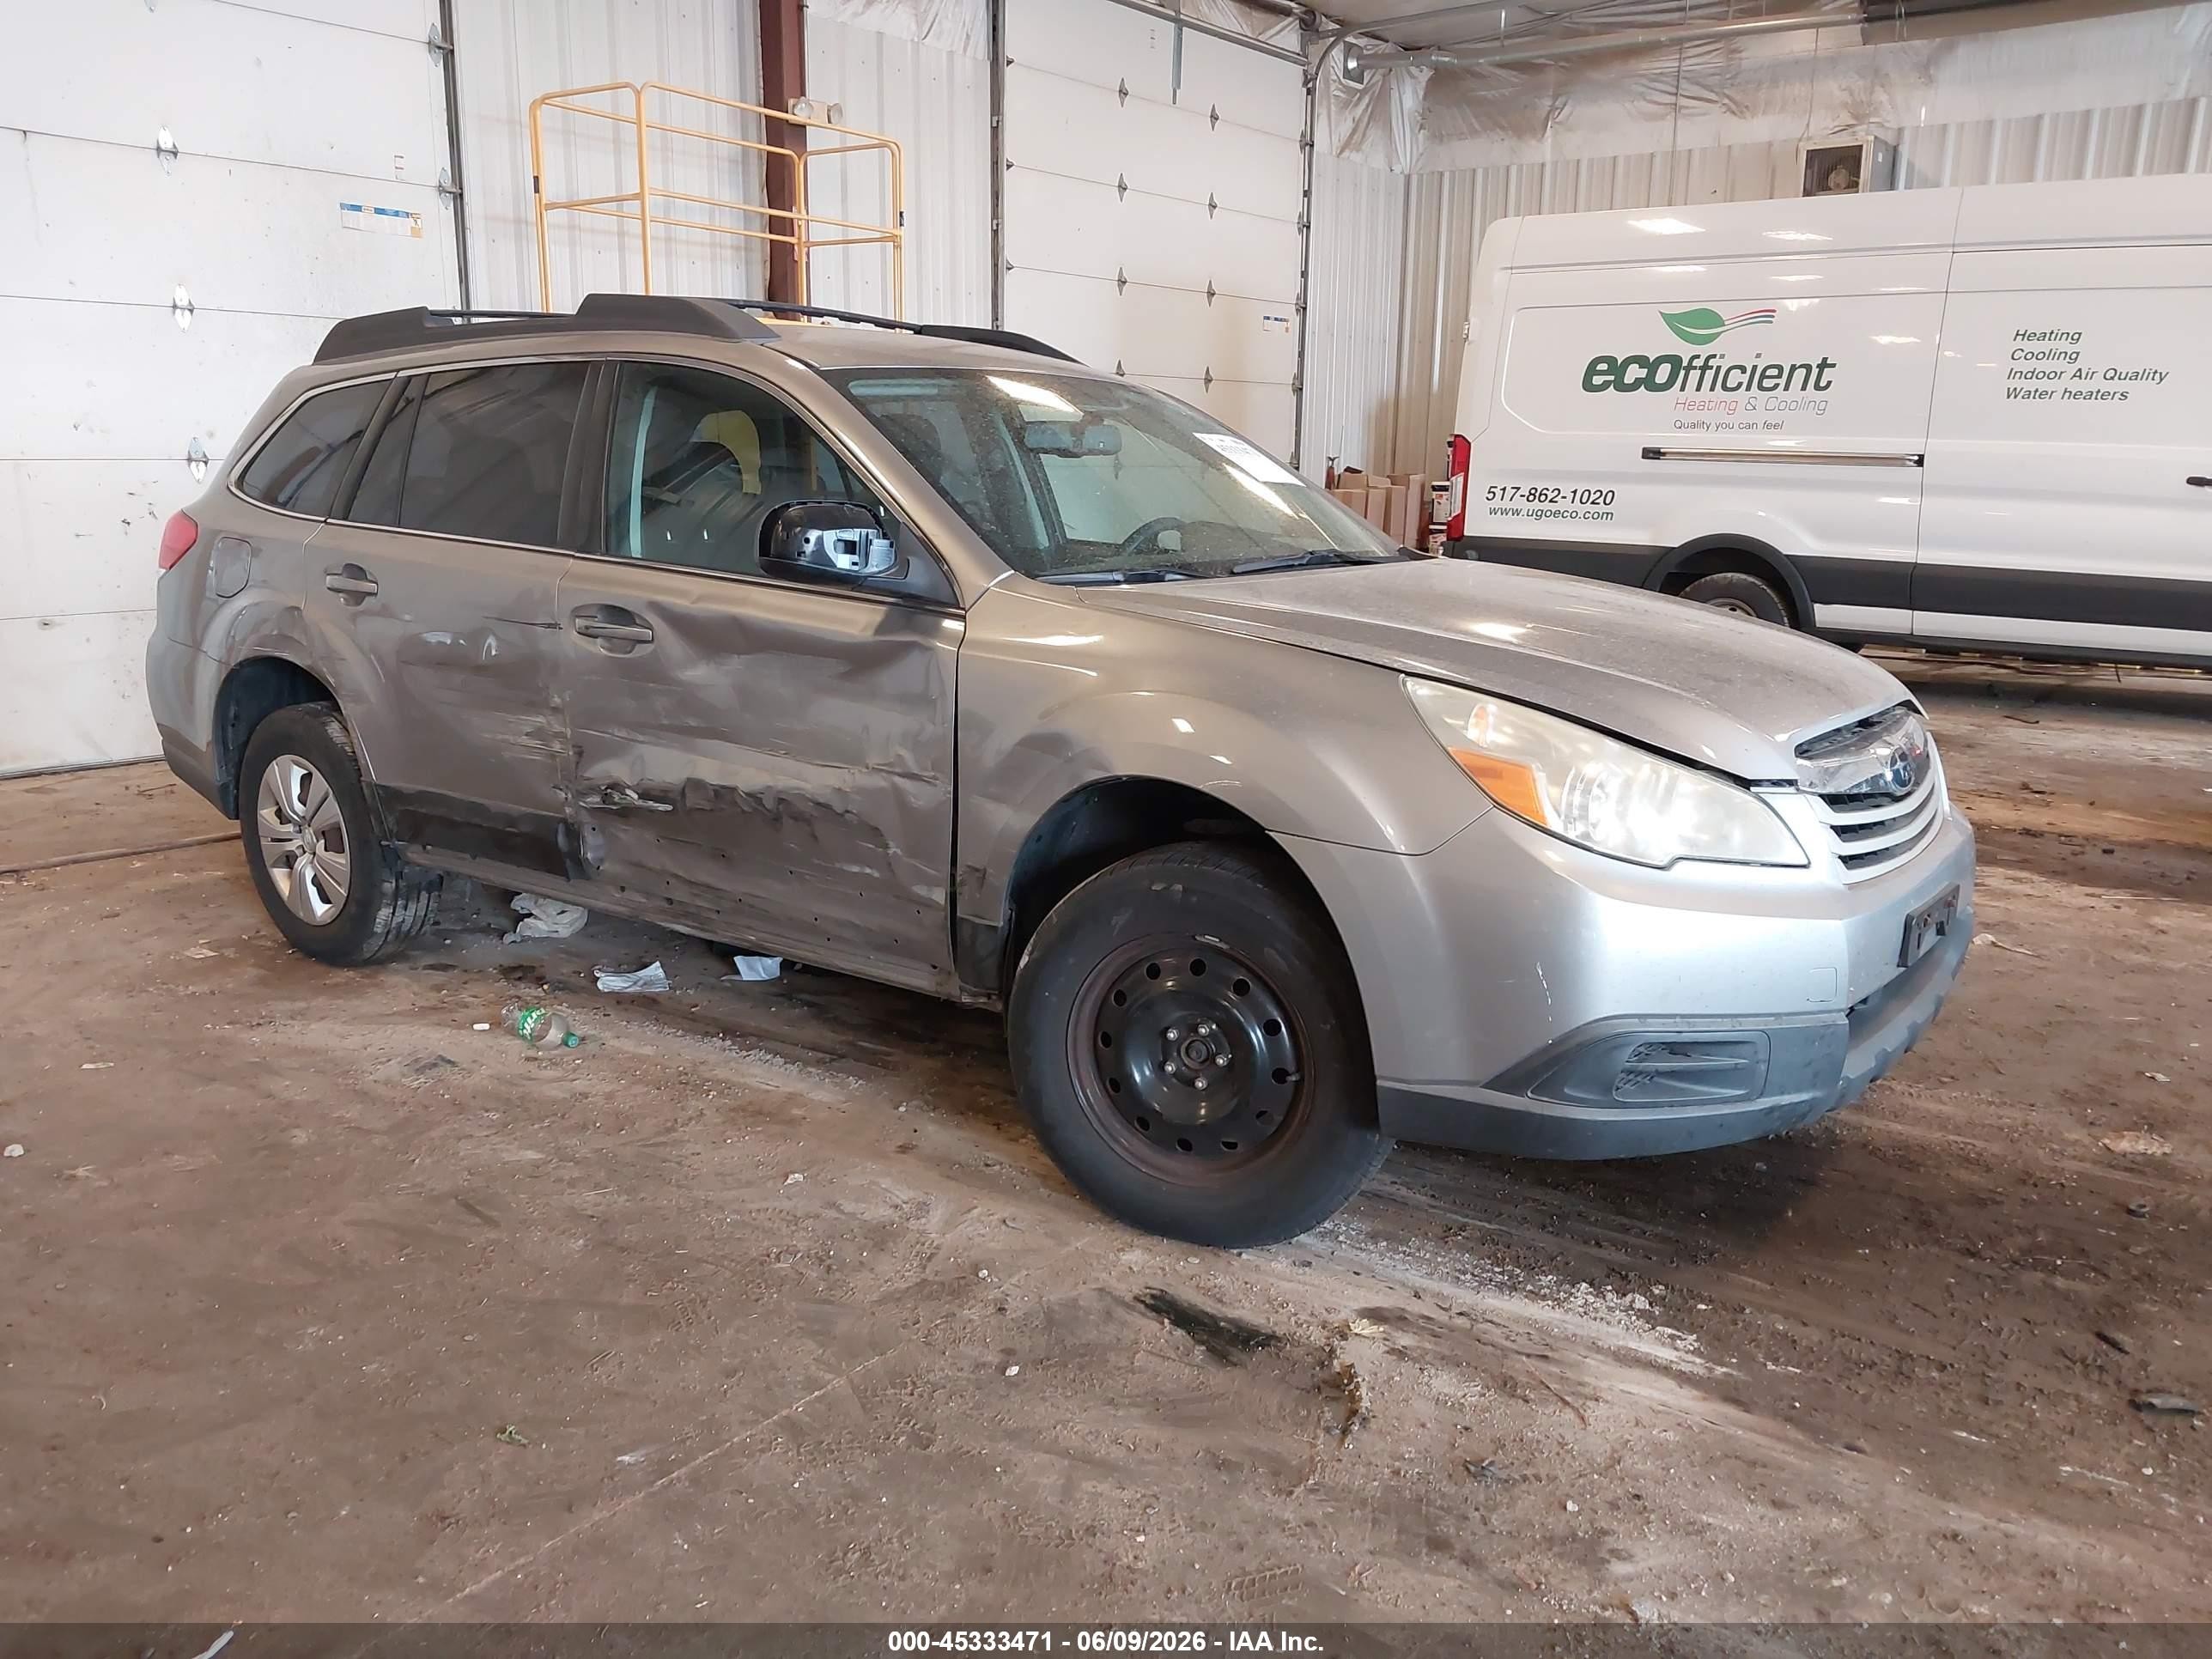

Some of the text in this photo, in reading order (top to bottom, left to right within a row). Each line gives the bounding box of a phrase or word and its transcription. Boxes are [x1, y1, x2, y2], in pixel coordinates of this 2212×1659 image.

[2013, 329, 2082, 344] Heating
[2010, 348, 2081, 364] Cooling
[2007, 368, 2169, 385] Indoor Air Quality
[2006, 387, 2130, 401] Water heaters
[1674, 396, 1828, 416] Heating & Cooling
[1674, 419, 1784, 432] Quality you can feel
[1486, 485, 1616, 506] 517-862-1020
[1488, 506, 1614, 521] www.ugoeco.com
